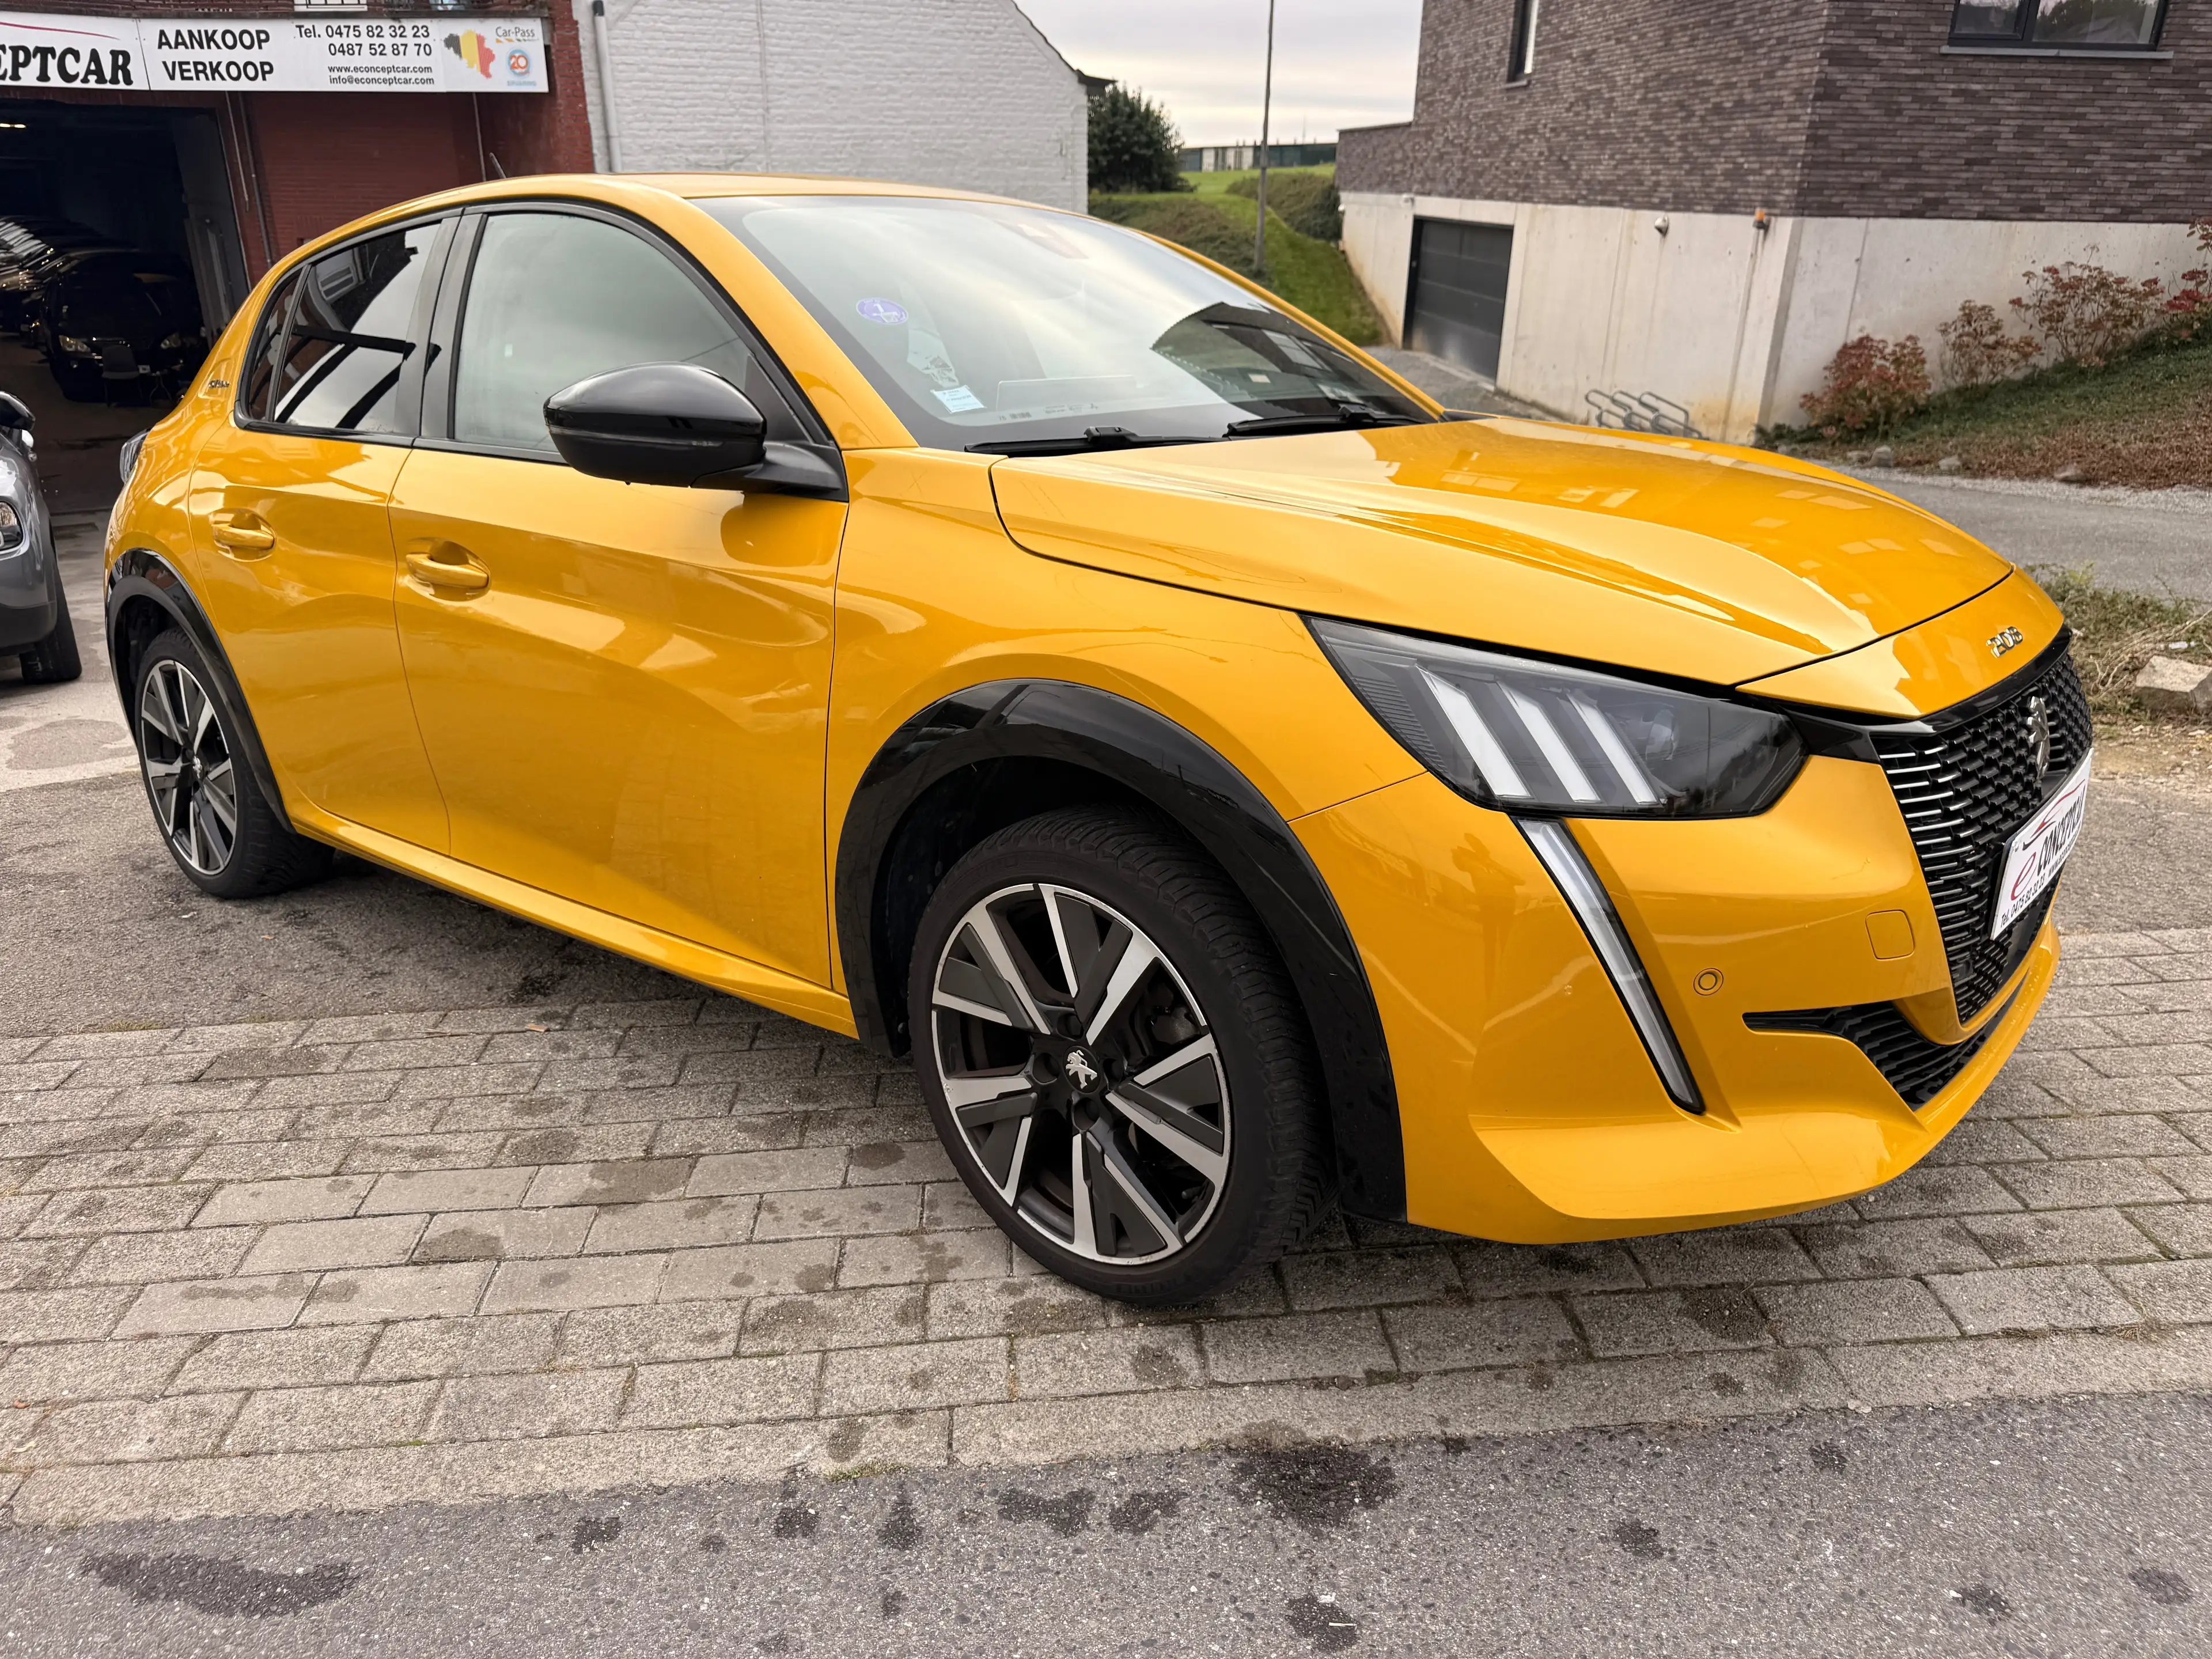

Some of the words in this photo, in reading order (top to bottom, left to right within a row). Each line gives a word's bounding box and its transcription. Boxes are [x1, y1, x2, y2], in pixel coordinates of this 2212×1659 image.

[296, 25, 321, 38] Tel.
[325, 25, 361, 38] 0475
[366, 25, 384, 38] 82
[389, 25, 407, 38] 32
[412, 25, 430, 38] 23
[495, 26, 535, 37] Car-Pass
[158, 29, 270, 50] AANKOOP
[328, 43, 363, 56] 0487
[369, 43, 387, 56] 52
[391, 43, 408, 56] 87
[414, 43, 433, 56] 70
[509, 55, 529, 70] 20
[162, 60, 274, 81] VERKOOP
[328, 65, 433, 75] www.econceptcar.com
[329, 75, 434, 86] info@econceptcar.com
[1986, 626, 2023, 658] 208
[2001, 908, 2010, 928] Tel.
[2011, 895, 2025, 915] 0475
